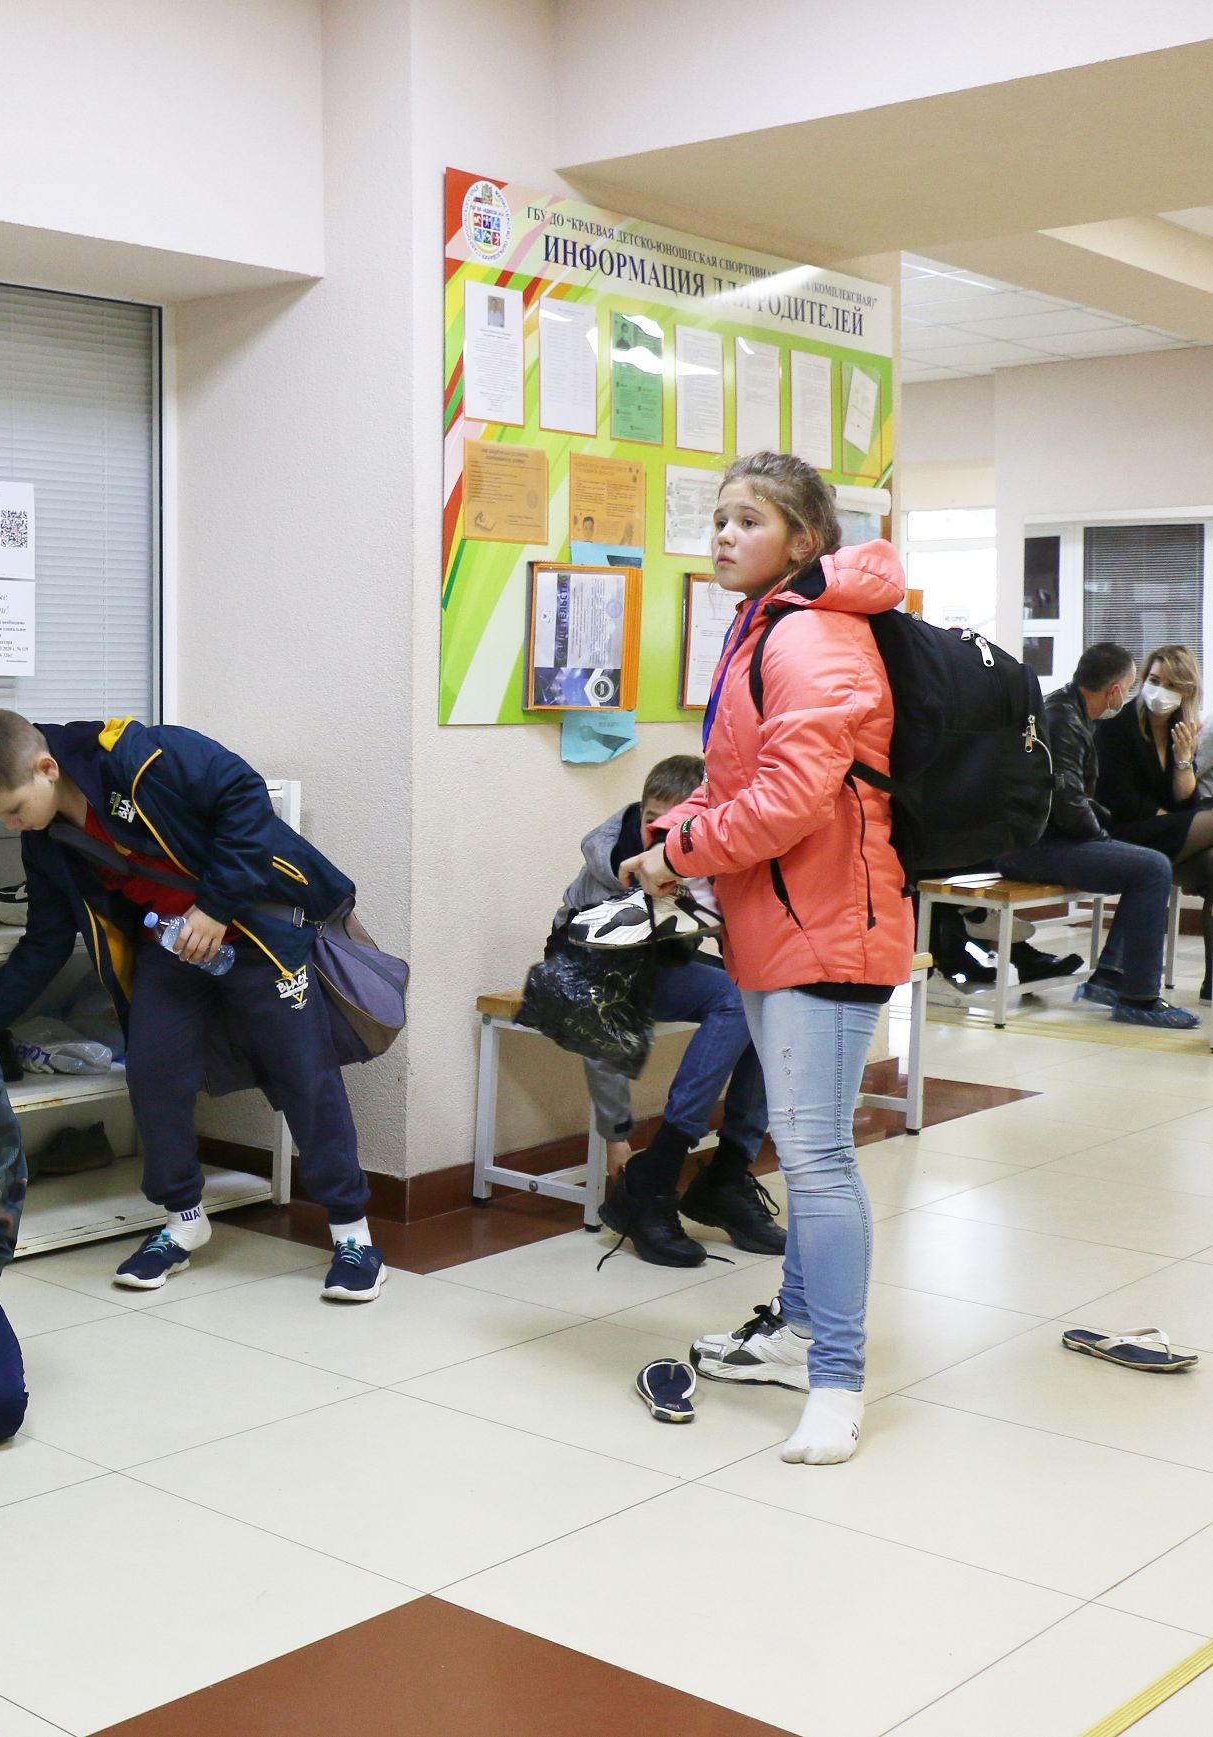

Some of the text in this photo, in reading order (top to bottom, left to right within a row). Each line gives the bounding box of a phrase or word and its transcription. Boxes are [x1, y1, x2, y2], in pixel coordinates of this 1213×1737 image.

[527, 206, 546, 221] ГБУ
[549, 212, 564, 227] ДО
[616, 229, 717, 266] ДЕТСКО-ЮНОШЕСКАЯ
[544, 234, 705, 298] ИНФОРМАЦИЯ
